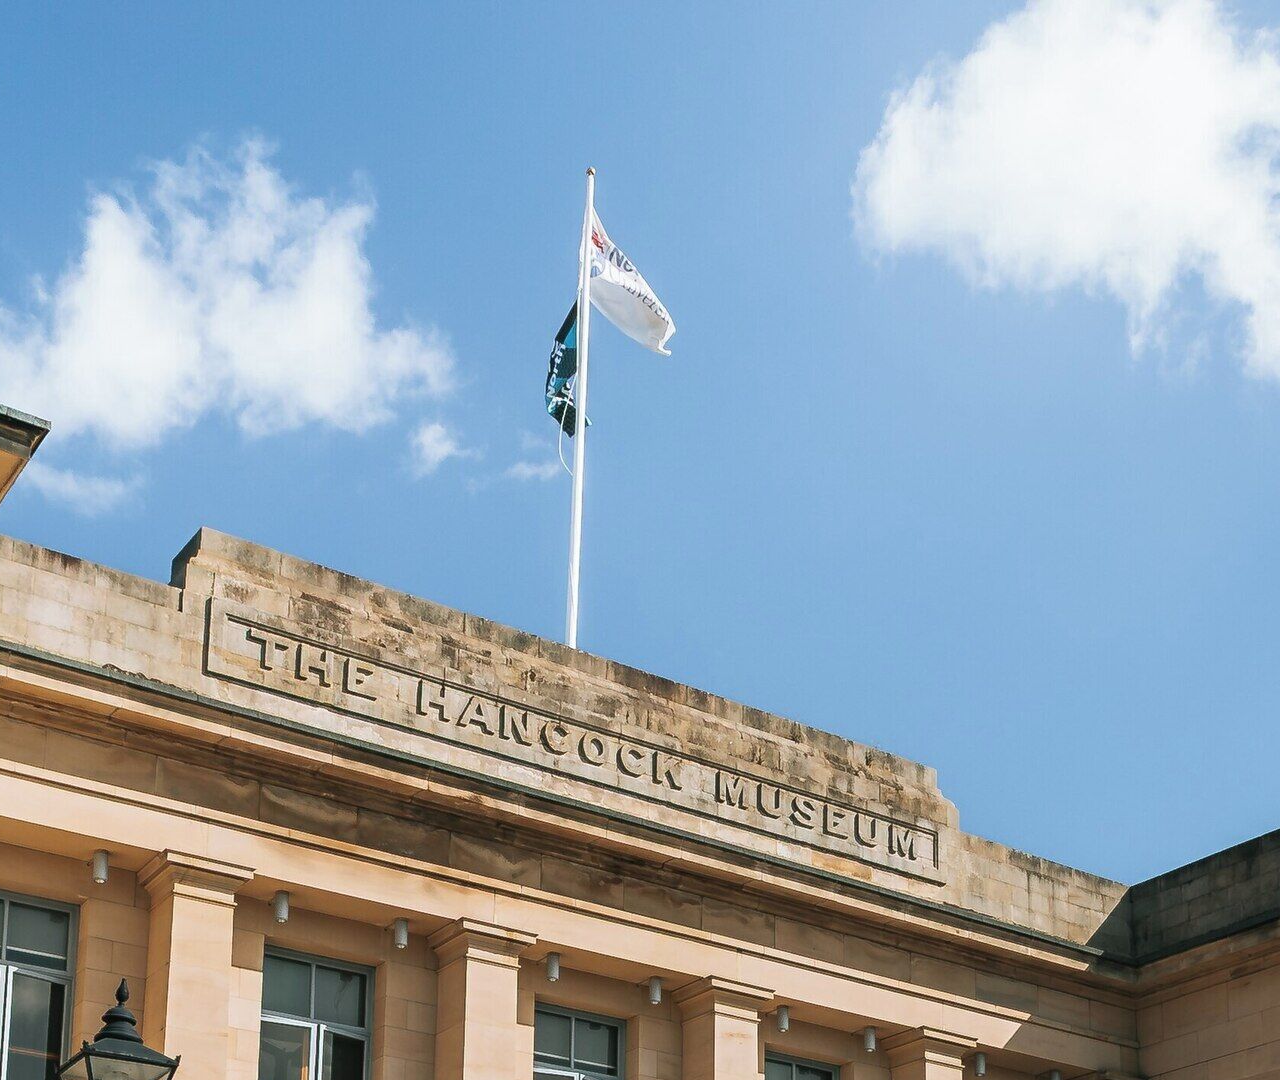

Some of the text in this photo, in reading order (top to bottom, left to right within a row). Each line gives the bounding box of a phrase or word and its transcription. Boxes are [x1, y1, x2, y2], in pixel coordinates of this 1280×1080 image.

[245, 627, 919, 862] THE HANCOCK MUSEUM
